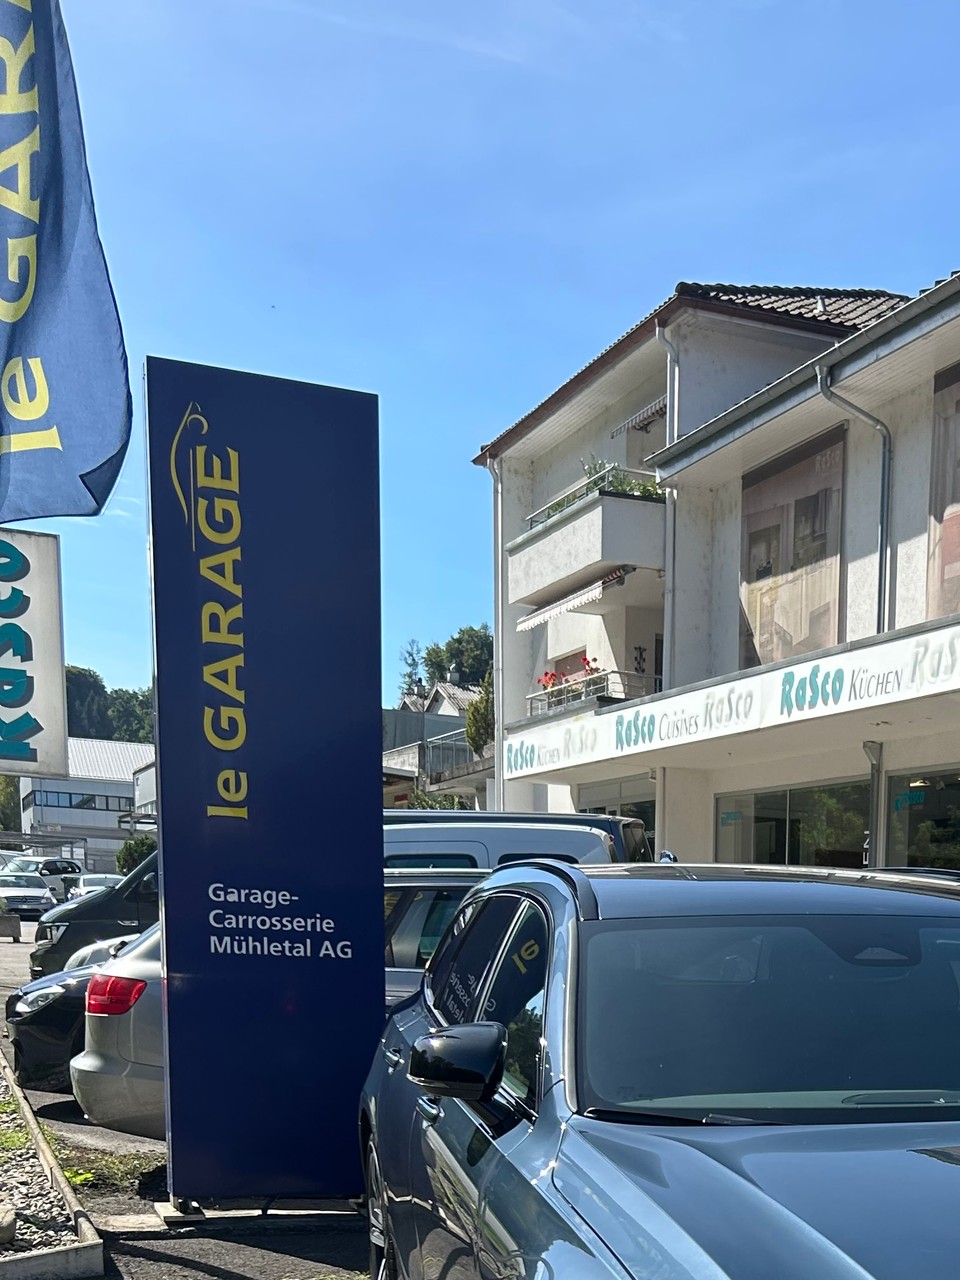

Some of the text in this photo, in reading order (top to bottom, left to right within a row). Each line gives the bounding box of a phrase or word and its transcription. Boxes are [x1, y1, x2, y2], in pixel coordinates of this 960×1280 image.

[0, 356, 63, 455] le
[196, 445, 249, 821] le GARAGE
[208, 882, 300, 910] Garage-
[209, 909, 335, 933] Carrosserie
[210, 935, 353, 959] Mühletal AG
